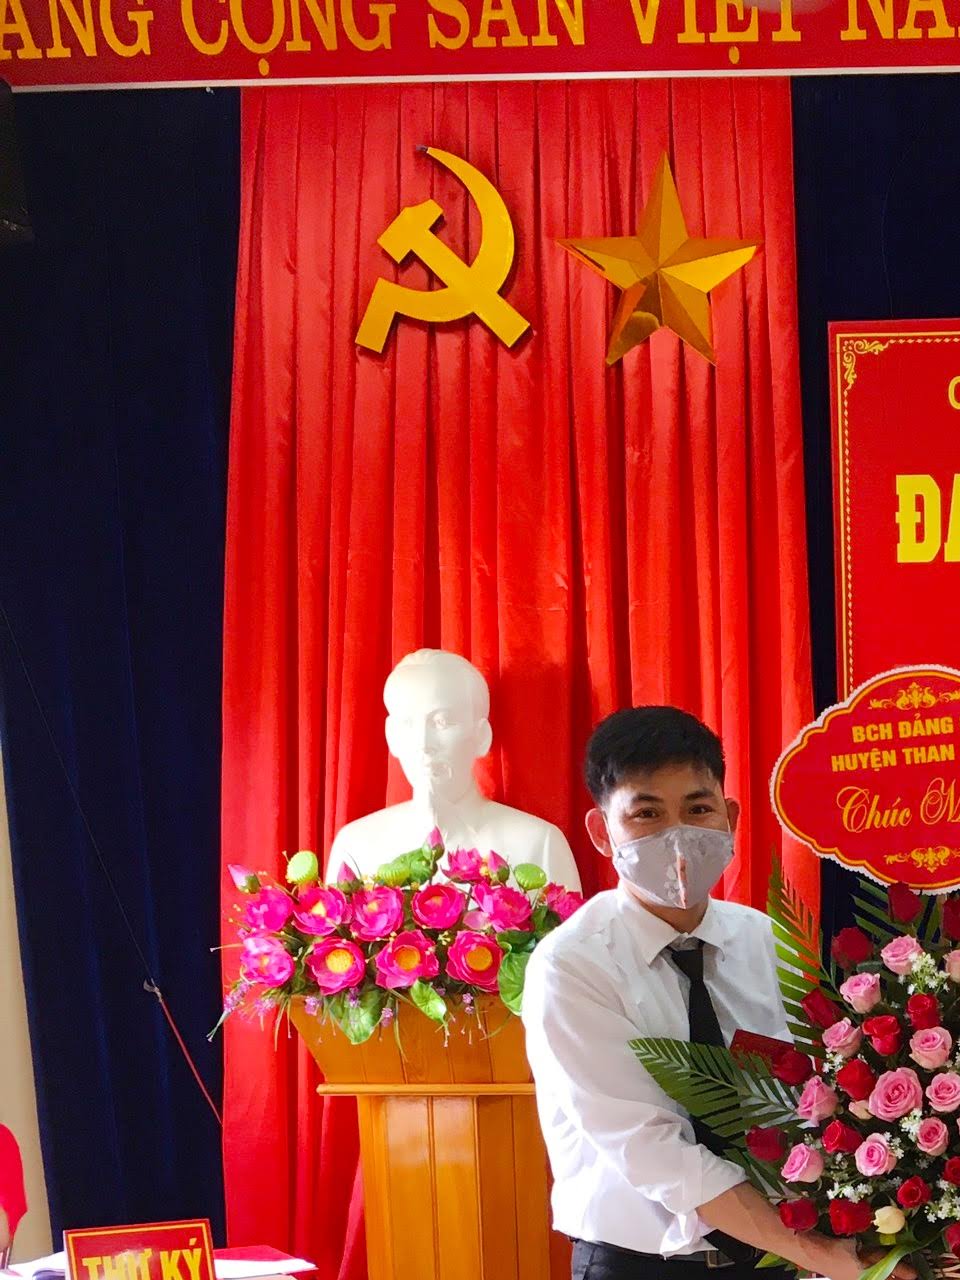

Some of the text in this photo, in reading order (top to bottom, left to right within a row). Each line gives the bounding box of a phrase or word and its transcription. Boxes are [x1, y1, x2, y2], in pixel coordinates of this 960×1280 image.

[852, 723, 892, 742] BCH
[898, 713, 953, 738] ĐẢNG
[832, 747, 897, 772] HUYỆN
[902, 744, 955, 765] THAN
[837, 786, 912, 833] Chúc
